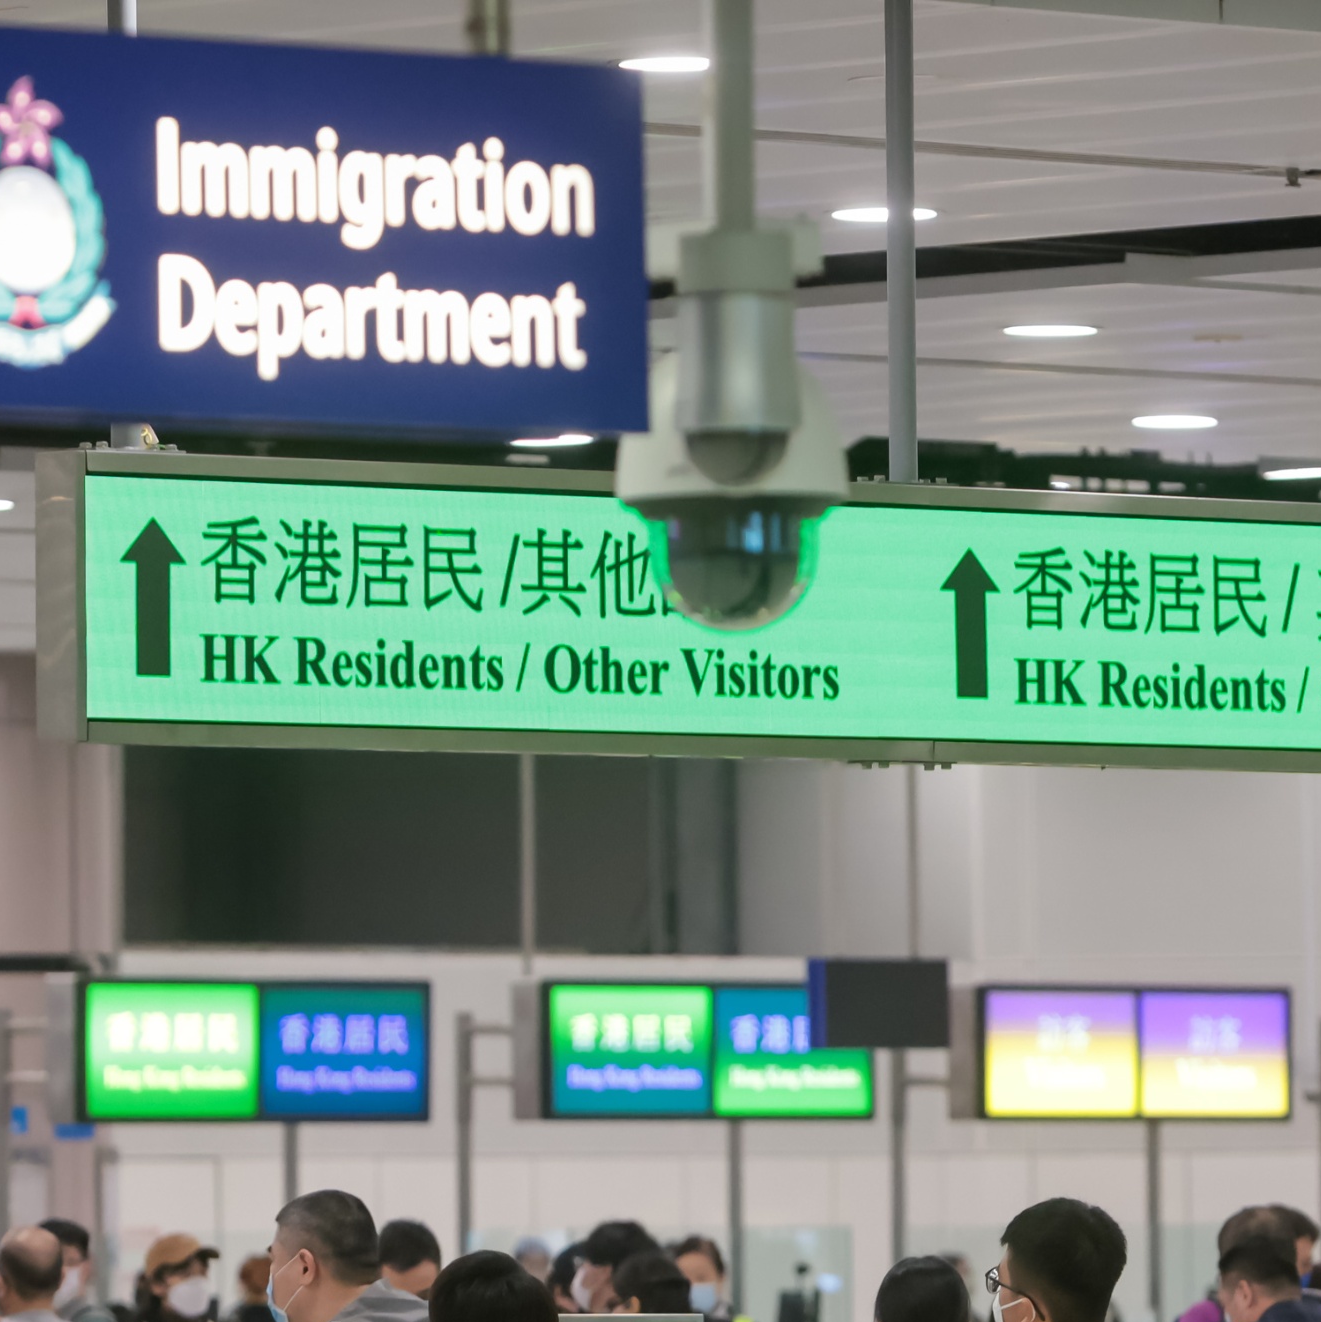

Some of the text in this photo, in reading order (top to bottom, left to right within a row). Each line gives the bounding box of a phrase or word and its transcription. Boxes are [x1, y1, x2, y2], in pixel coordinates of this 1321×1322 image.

[155, 115, 595, 251] Immigration
[156, 253, 587, 380] Department
[200, 633, 841, 702] HK Residents / Other Visitors
[1014, 657, 1086, 708] HK
[1098, 659, 1287, 715] Residents
[1296, 665, 1310, 714] /
